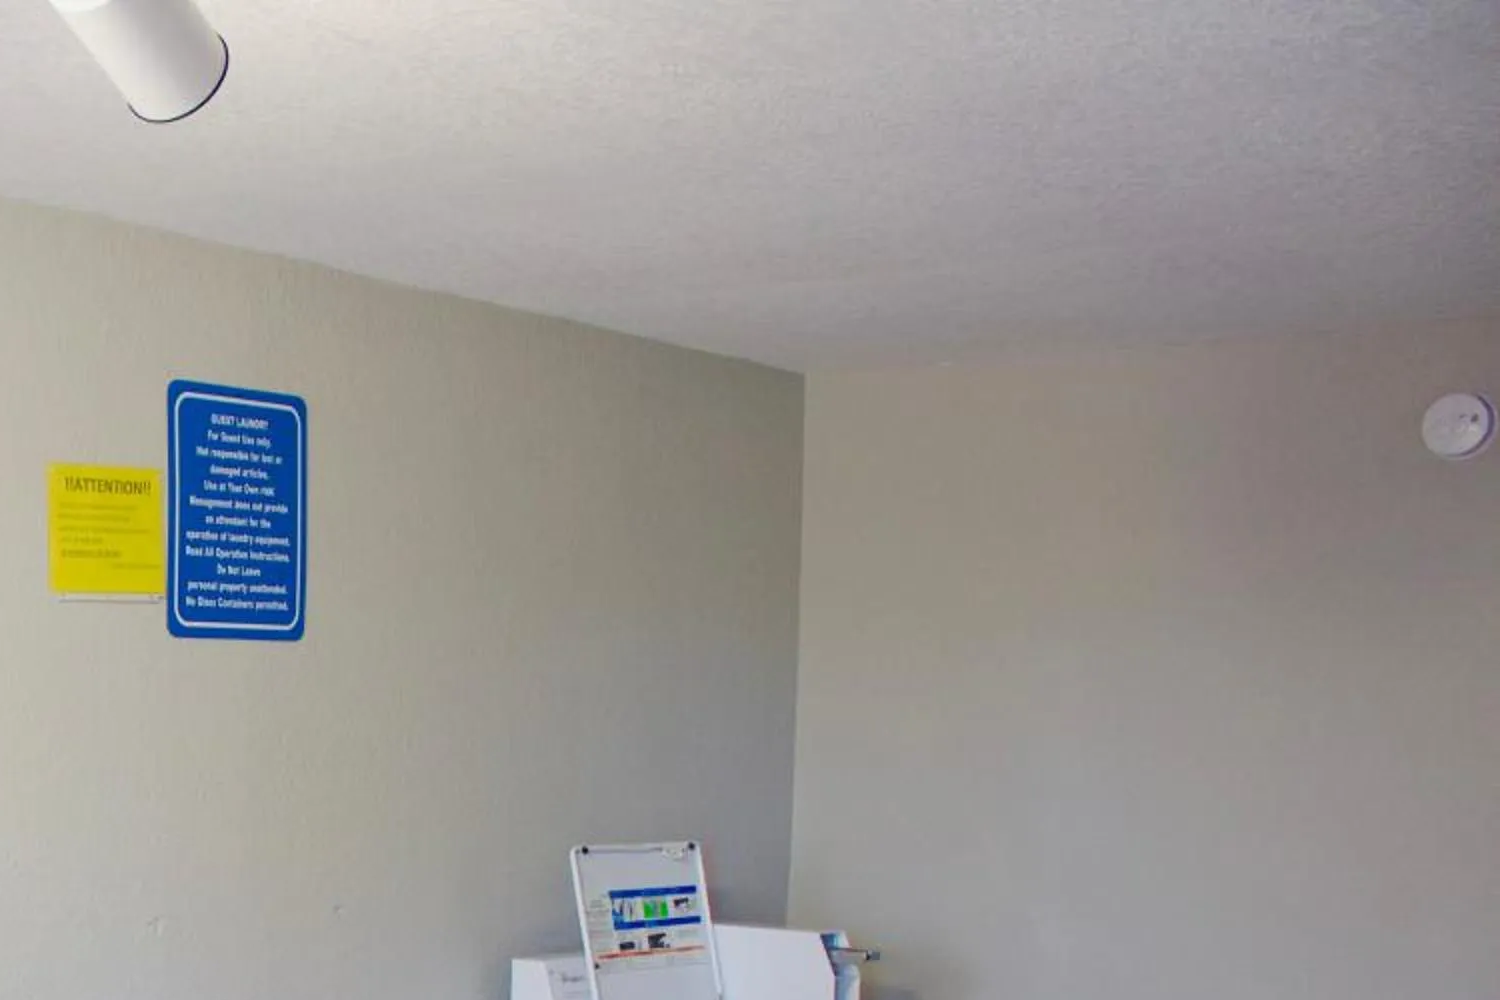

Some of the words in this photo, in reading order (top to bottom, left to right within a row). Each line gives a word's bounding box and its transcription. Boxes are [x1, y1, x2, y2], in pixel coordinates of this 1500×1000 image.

[211, 413, 235, 426] GUEST
[236, 417, 269, 430] LAUNDRY
[210, 449, 250, 461] responsible
[210, 464, 242, 478] damaged
[189, 495, 233, 510] Management
[264, 504, 288, 514] provide
[216, 515, 249, 527] attendant
[186, 530, 219, 542] operation
[228, 532, 253, 546] laundry
[186, 545, 204, 557] Read
[242, 566, 261, 577] Leave
[187, 581, 219, 593] personal
[220, 583, 248, 595] property
[218, 597, 255, 610] Containers
